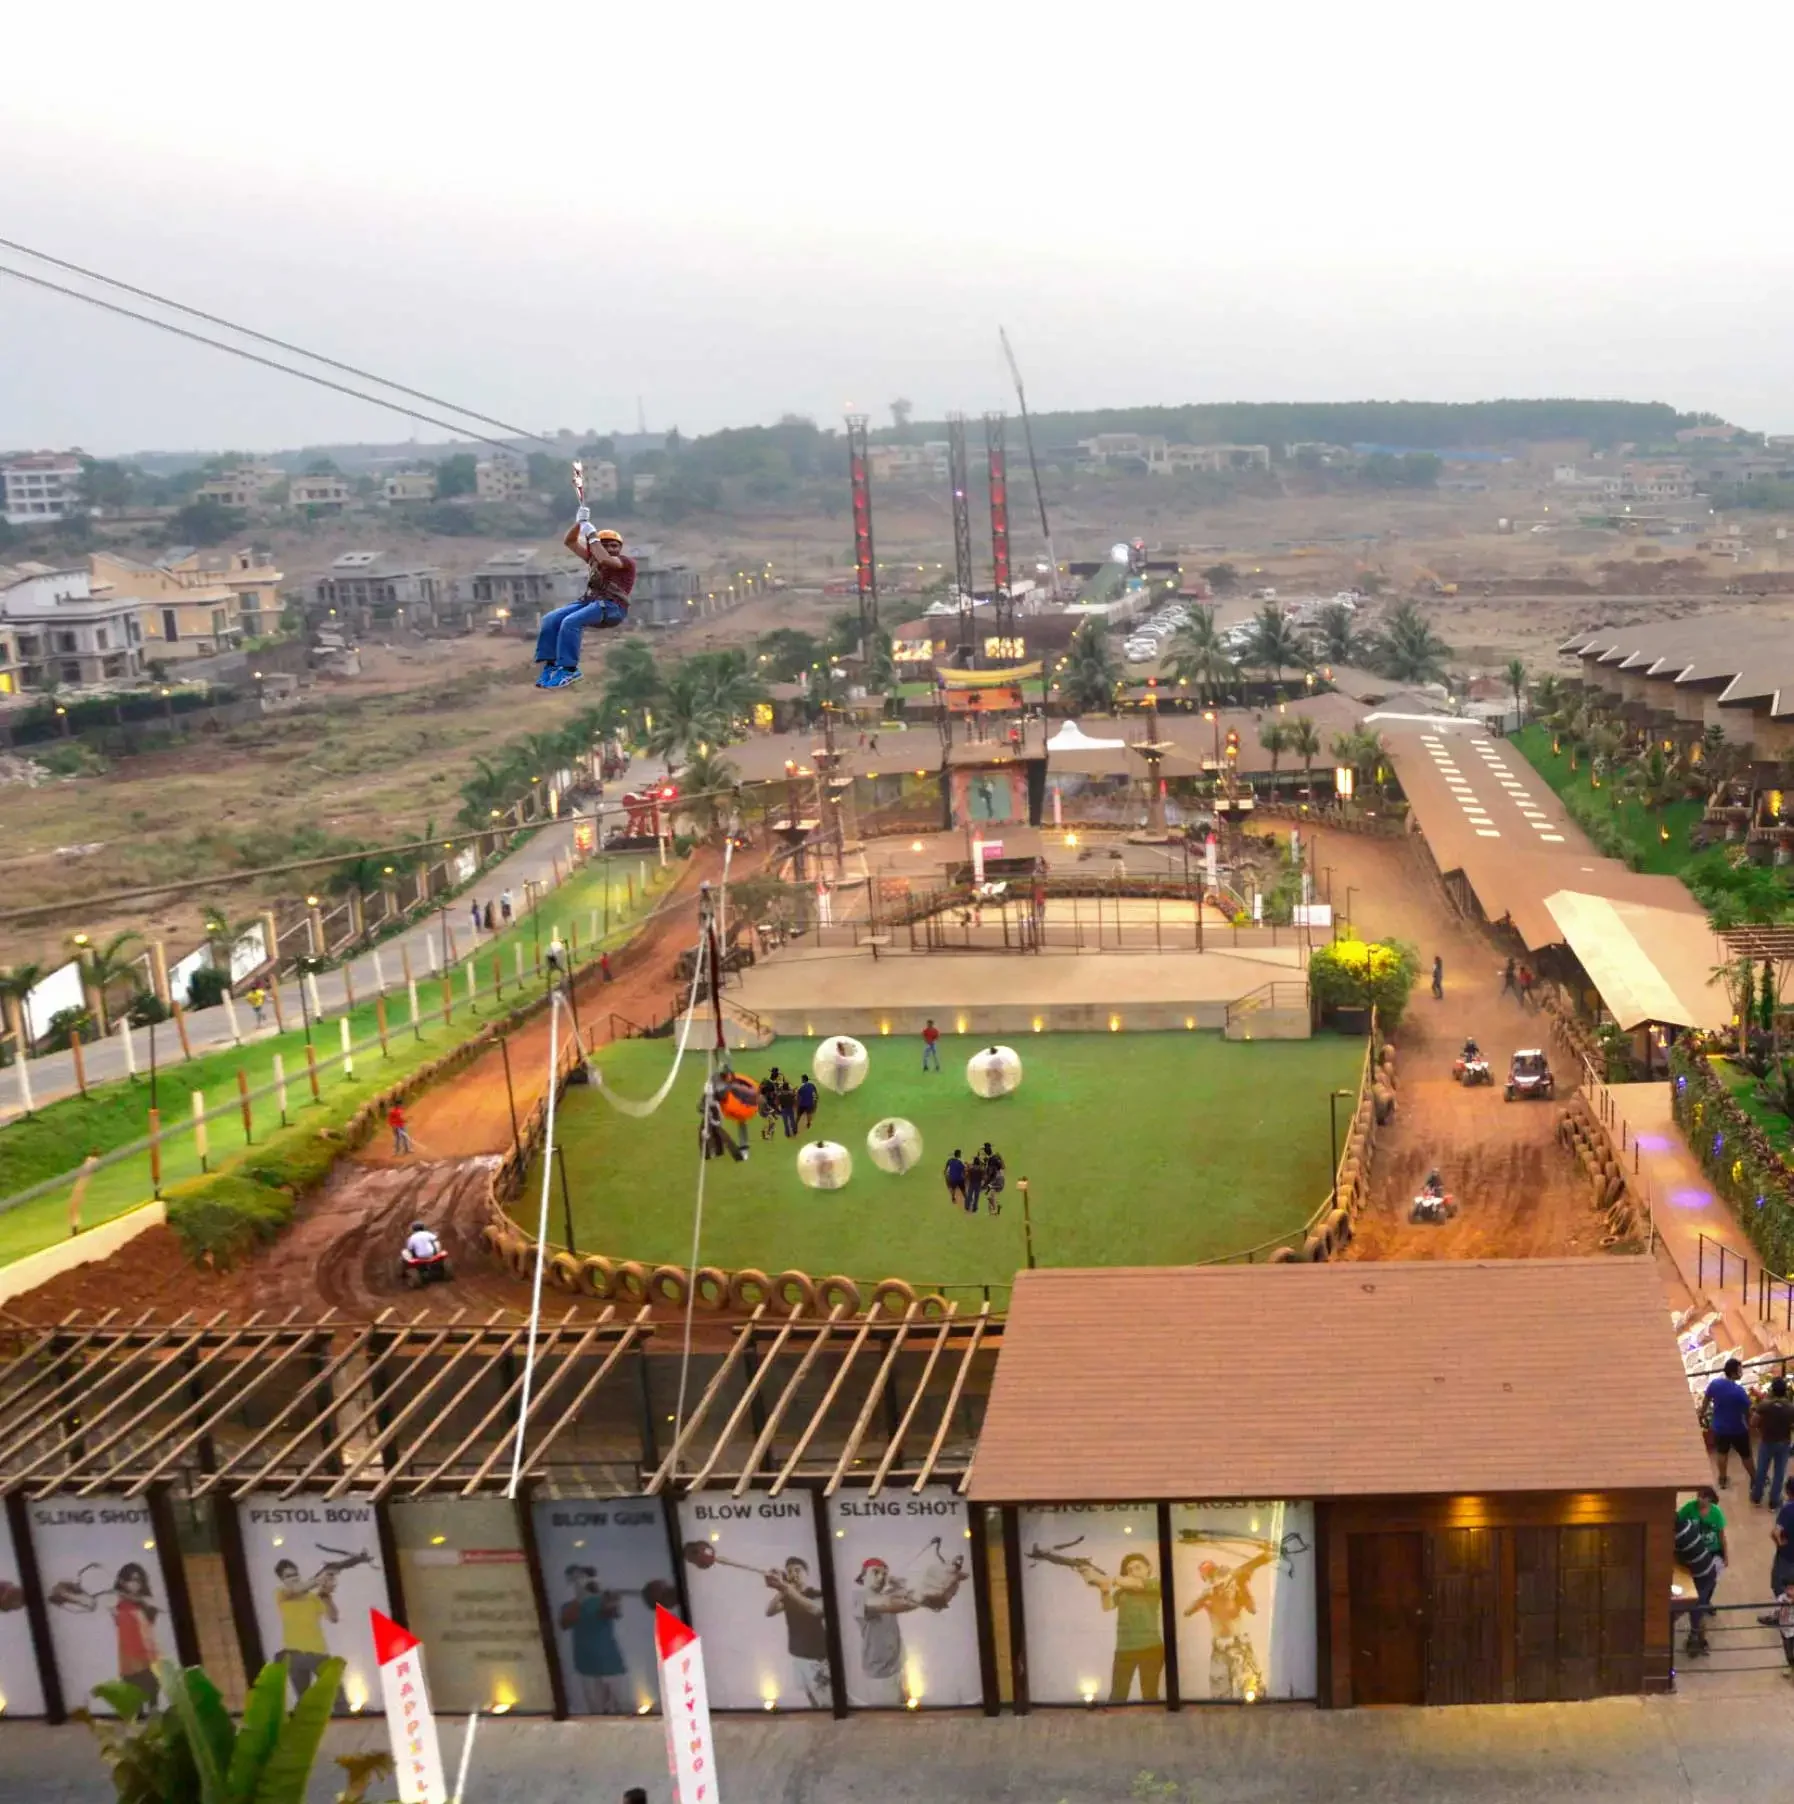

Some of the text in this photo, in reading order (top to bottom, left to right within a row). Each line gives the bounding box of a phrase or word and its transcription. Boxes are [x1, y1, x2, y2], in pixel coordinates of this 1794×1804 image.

[250, 1508, 371, 1524] PISTOL BOW
[695, 1503, 801, 1520] BLOW GUN
[841, 1500, 958, 1516] SLING SHOT
